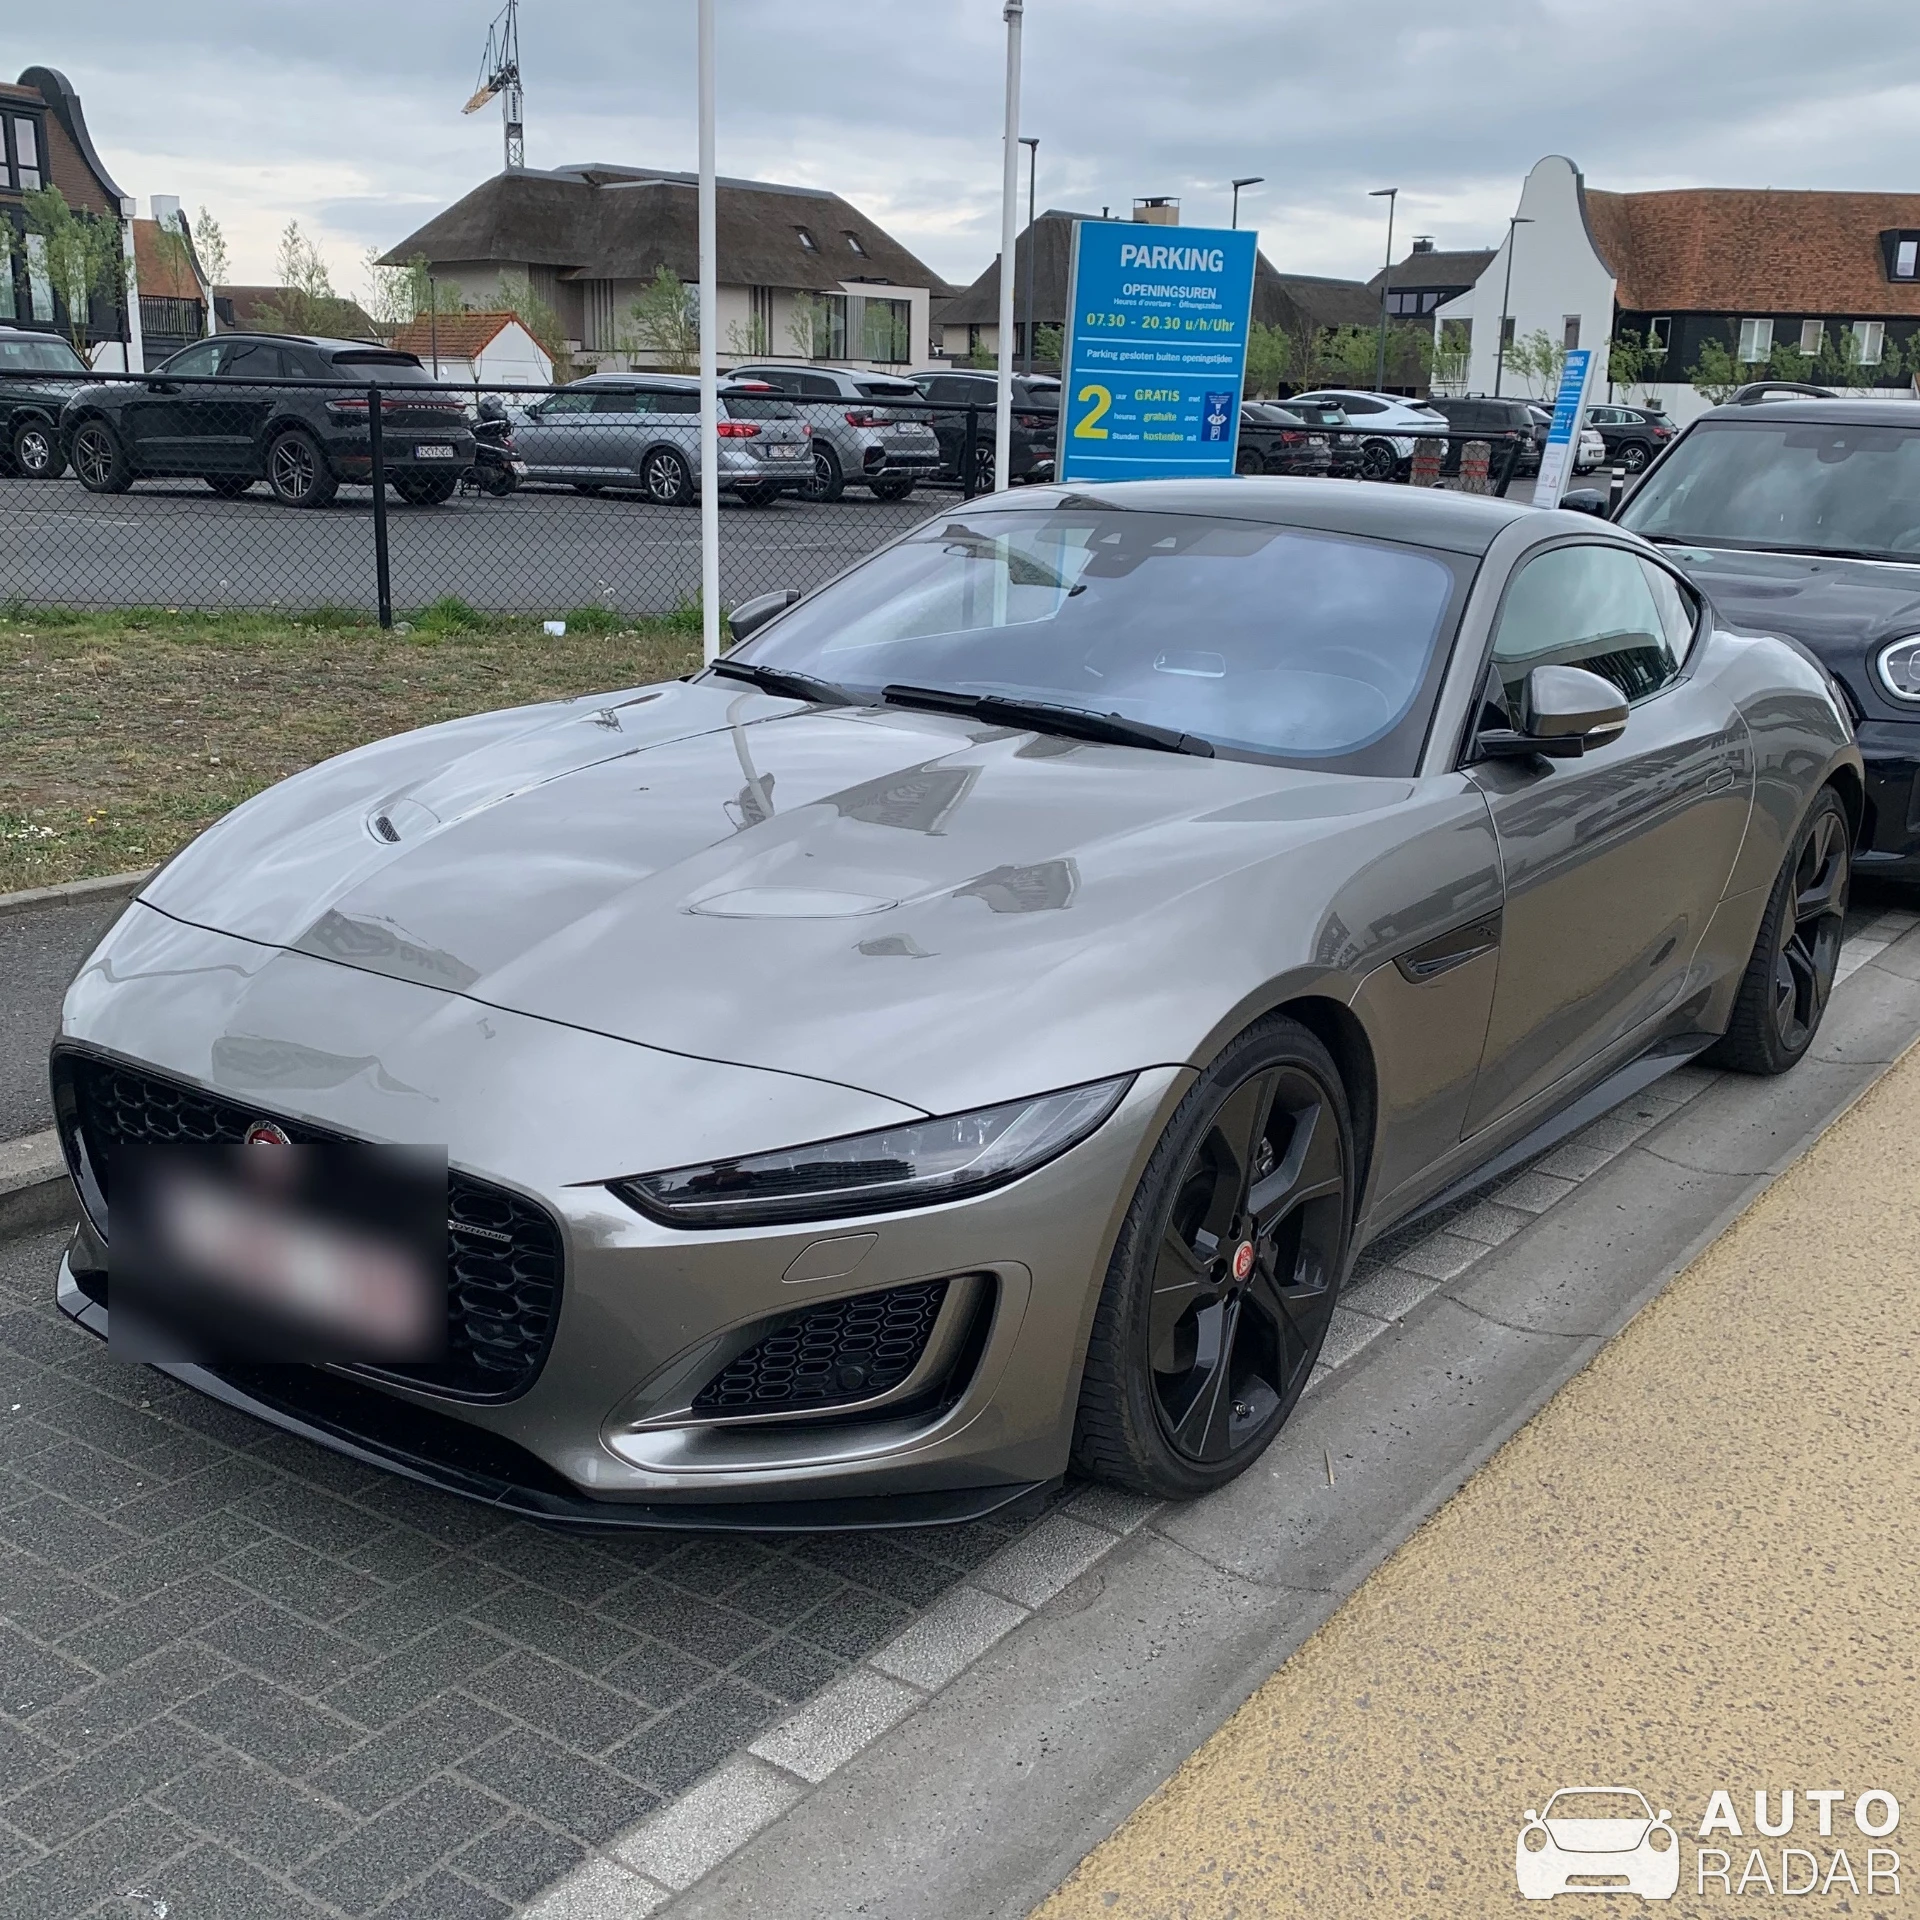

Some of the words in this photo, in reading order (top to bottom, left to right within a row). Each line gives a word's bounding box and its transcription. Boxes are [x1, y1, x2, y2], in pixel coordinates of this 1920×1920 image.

[1120, 244, 1224, 272] PARKING
[1122, 283, 1217, 300] OPENINGSUREN
[1113, 298, 1137, 306] Heures
[1086, 313, 1126, 328] 07.30
[1141, 315, 1181, 330] 20.30
[1185, 317, 1235, 332] u/h/Uhr
[1086, 349, 1118, 361] Parking
[1120, 351, 1154, 361] gesloten
[1156, 352, 1180, 361] buiten
[1182, 354, 1233, 364] openingstijden
[1134, 389, 1180, 402] GRATIS
[1073, 384, 1112, 440] 2
[1113, 412, 1137, 421] heures
[1112, 432, 1140, 440] Stunden
[1143, 430, 1184, 442] kostenlos
